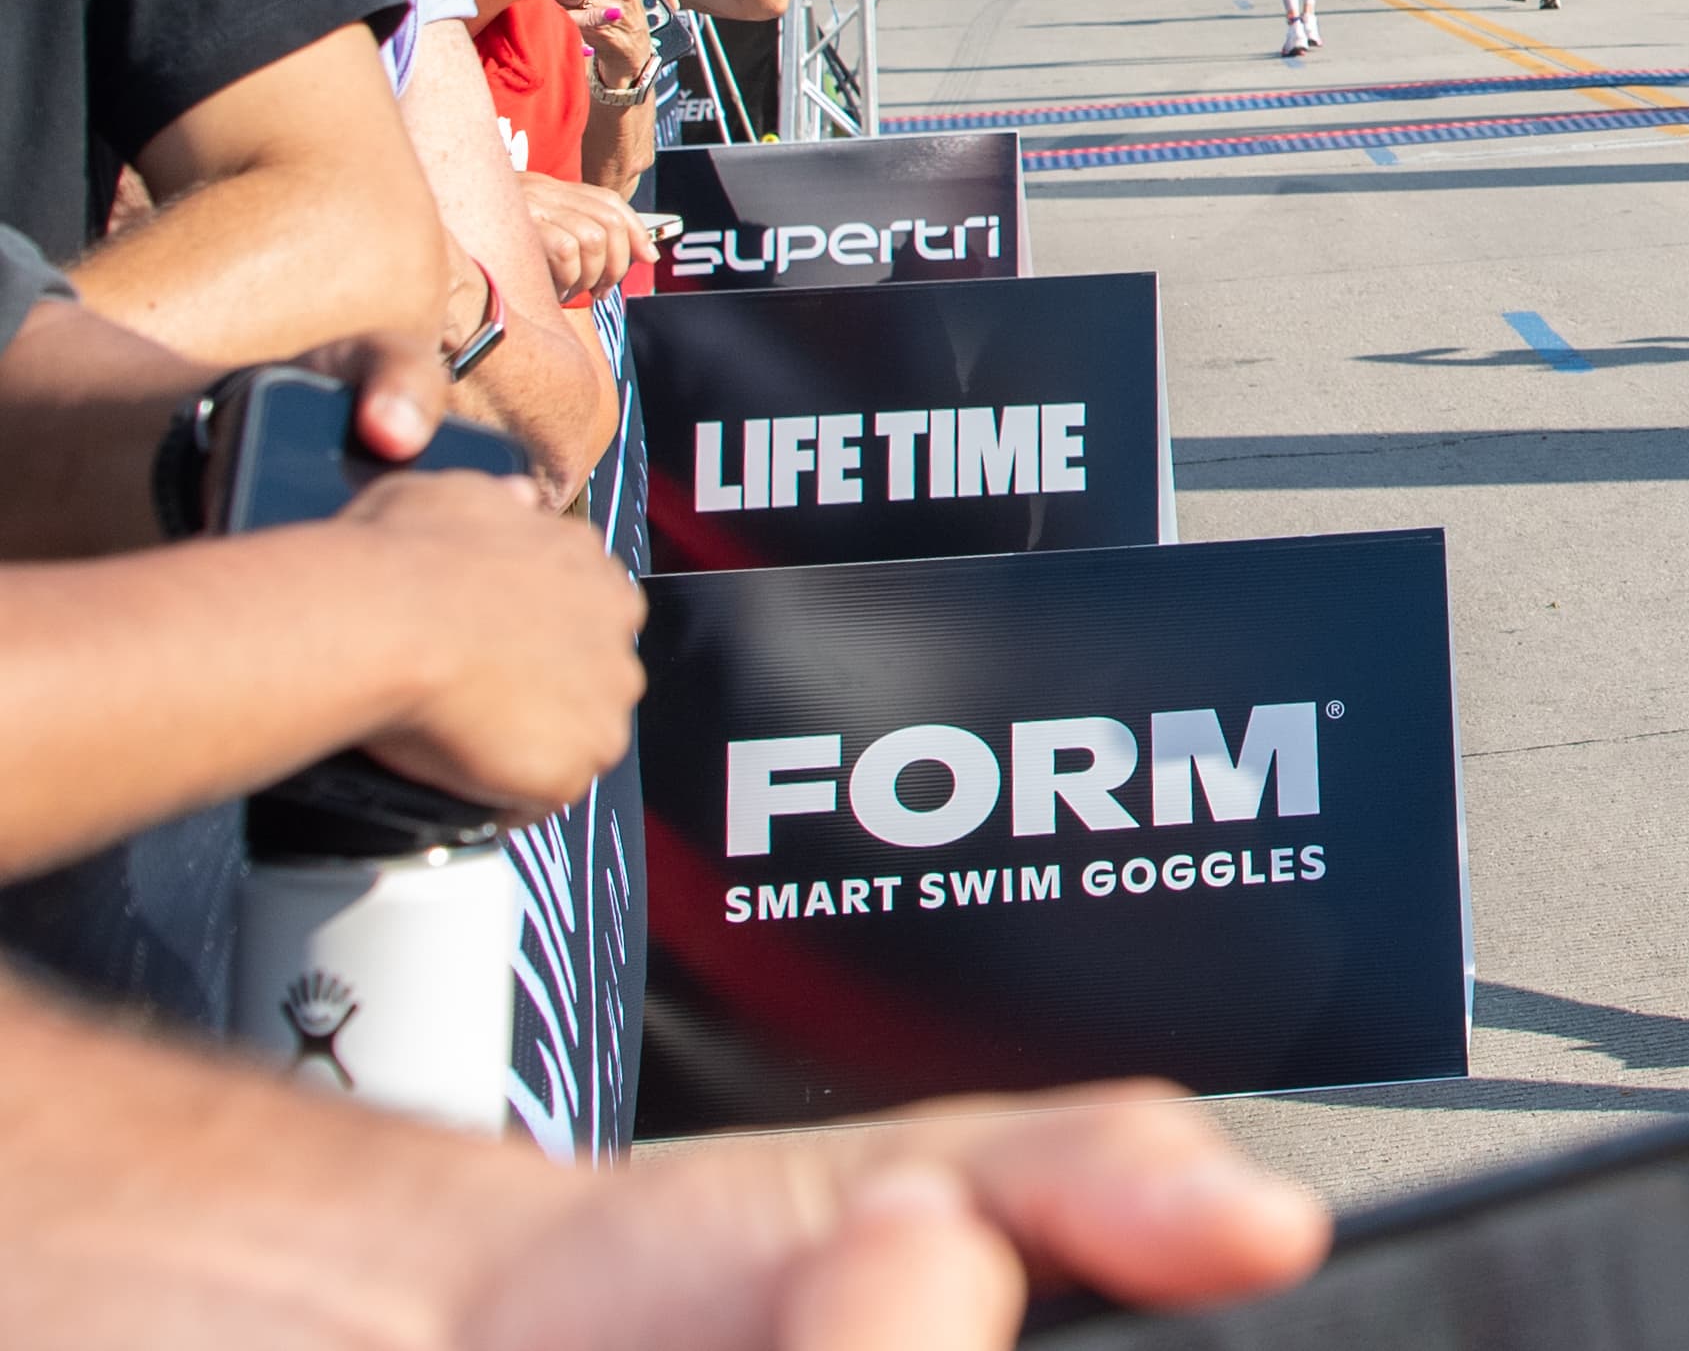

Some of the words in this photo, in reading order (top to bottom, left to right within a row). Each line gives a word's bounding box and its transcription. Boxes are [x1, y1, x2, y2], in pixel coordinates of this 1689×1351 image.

[672, 215, 1000, 277] supertri
[695, 413, 863, 513] LIFE
[874, 402, 1087, 502] TIME
[726, 876, 902, 923] SMART
[918, 865, 1062, 910] SWIM
[1081, 844, 1327, 898] GOGGLES
